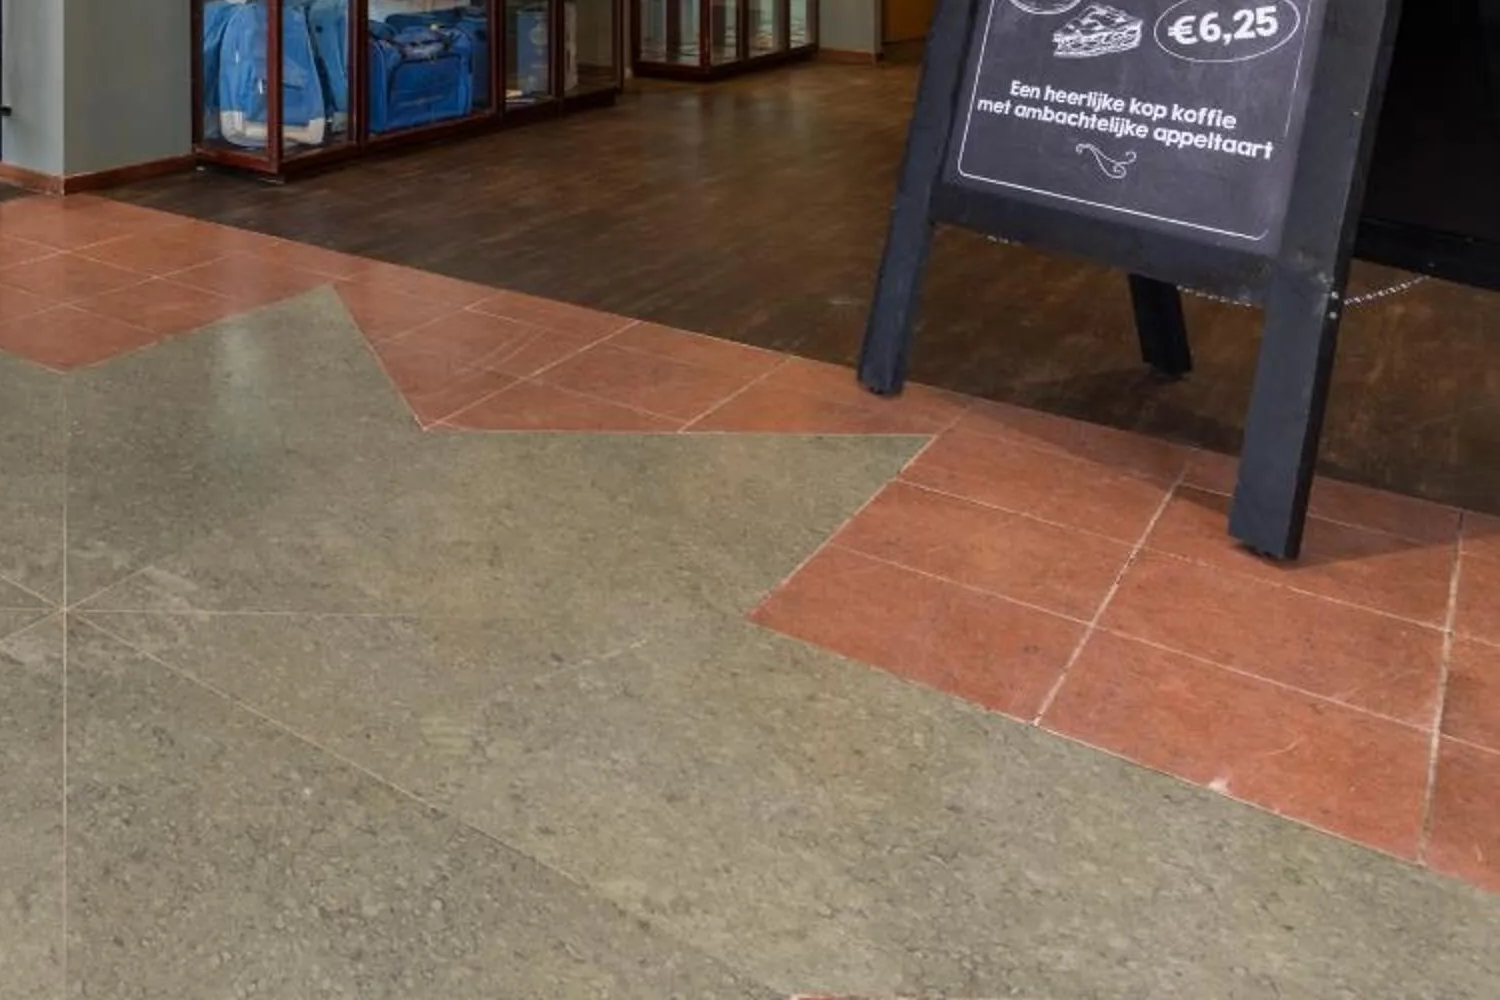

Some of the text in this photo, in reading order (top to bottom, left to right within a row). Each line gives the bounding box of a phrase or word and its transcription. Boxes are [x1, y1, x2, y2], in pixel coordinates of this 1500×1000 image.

[1167, 6, 1279, 46] €6,25
[1010, 80, 1237, 129] Een heerlijke kop koffie
[977, 99, 1274, 160] met ambachtelijke appeltaart
